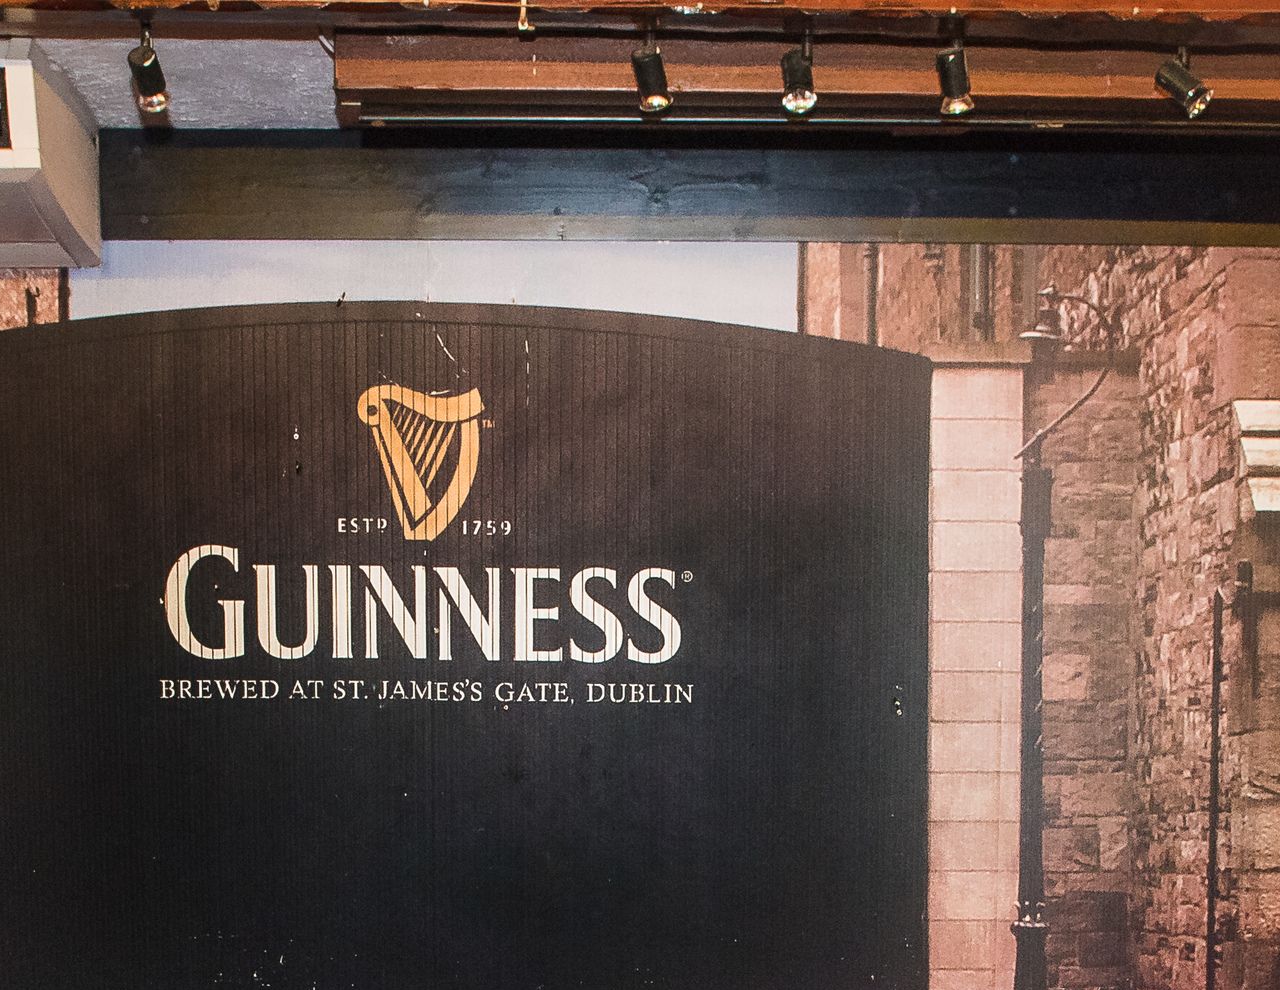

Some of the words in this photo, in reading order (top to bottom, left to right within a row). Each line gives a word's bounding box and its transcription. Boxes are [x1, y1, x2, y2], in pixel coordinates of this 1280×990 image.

[462, 519, 512, 536] 1759
[159, 679, 280, 700] BREWED
[288, 679, 324, 700] AT
[332, 679, 369, 700] ST.
[377, 678, 483, 702] JAMES'S
[494, 681, 575, 705] GATE,
[586, 683, 695, 704] DUBLIN
